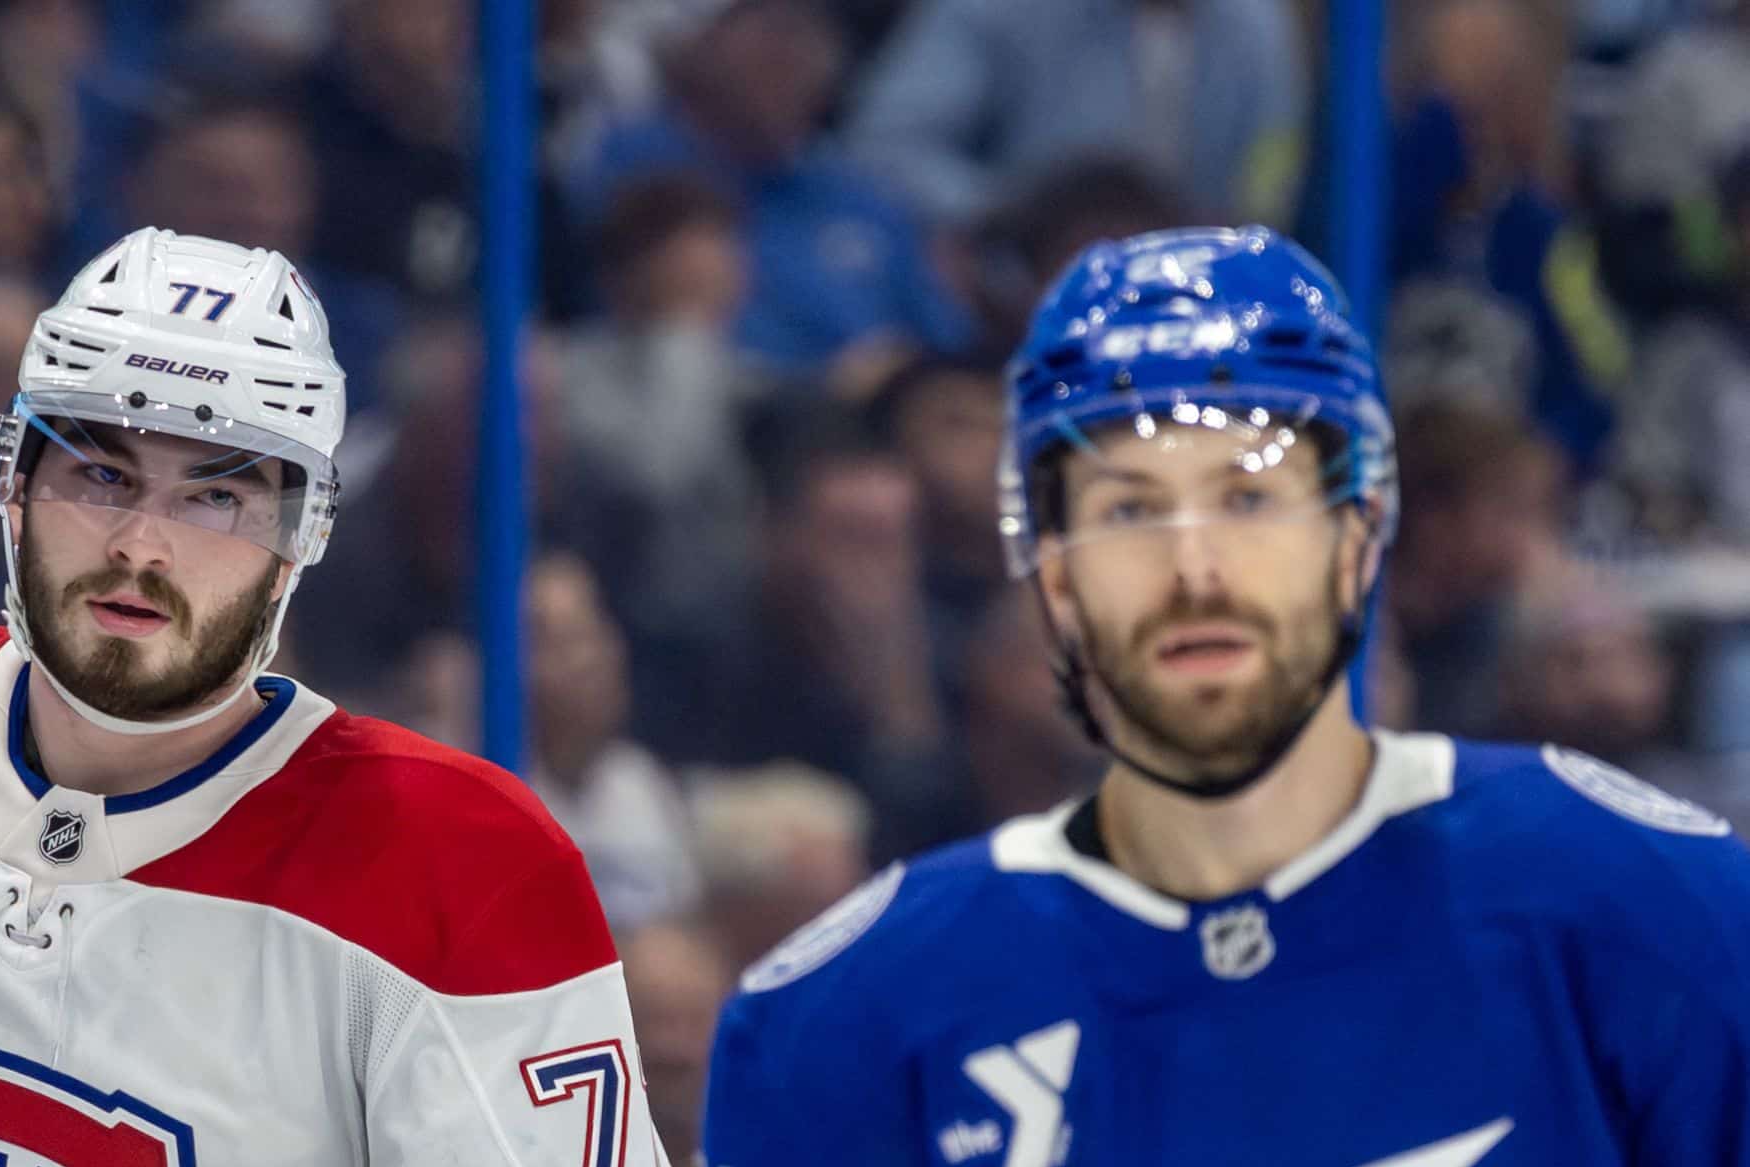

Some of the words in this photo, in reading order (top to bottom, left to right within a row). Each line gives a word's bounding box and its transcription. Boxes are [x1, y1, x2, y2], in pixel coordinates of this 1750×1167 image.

[169, 281, 236, 322] 77
[125, 353, 229, 385] BAUER
[46, 825, 79, 851] NHL
